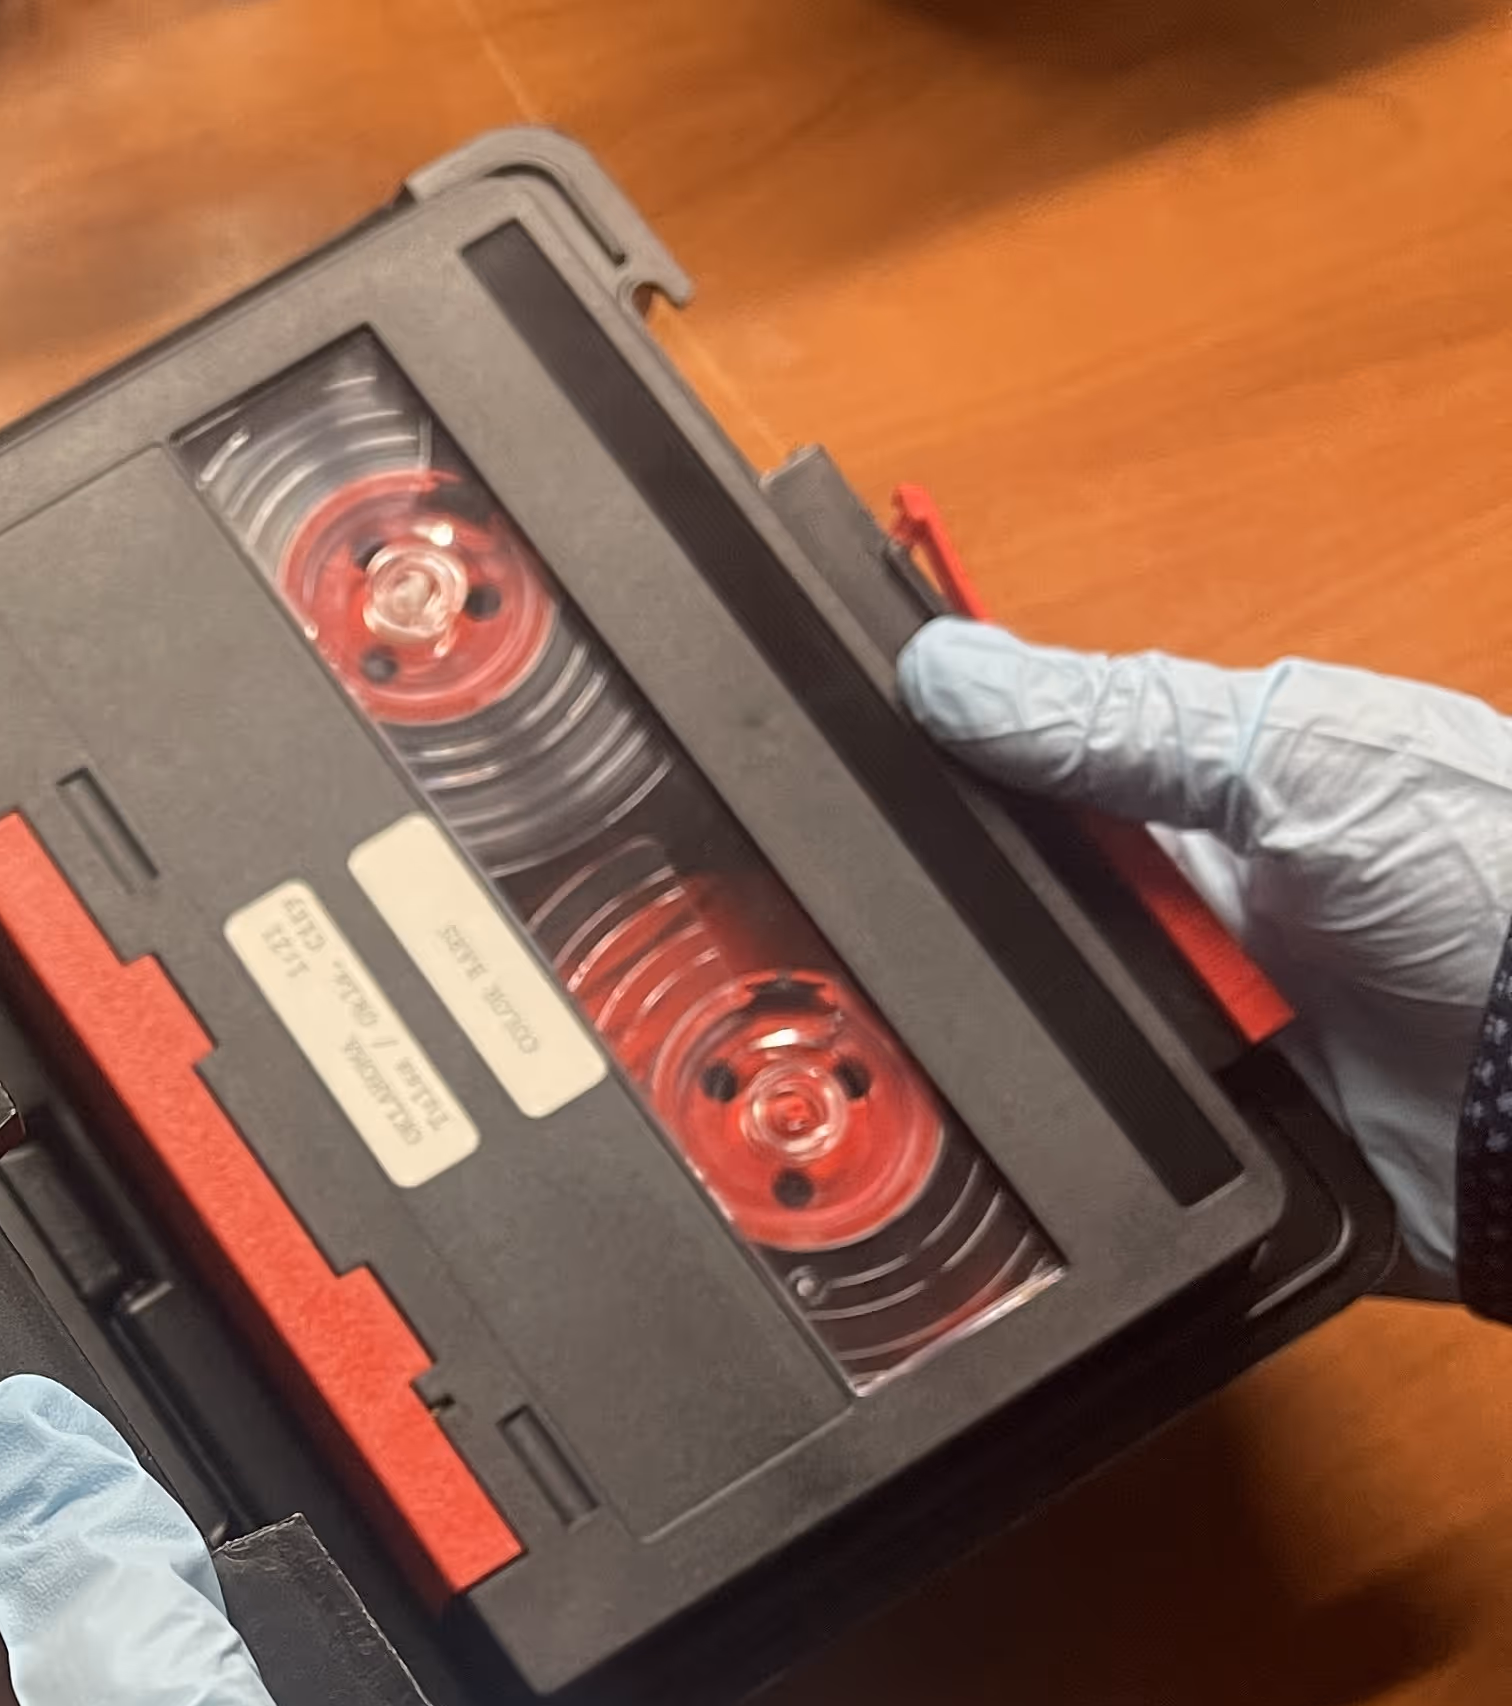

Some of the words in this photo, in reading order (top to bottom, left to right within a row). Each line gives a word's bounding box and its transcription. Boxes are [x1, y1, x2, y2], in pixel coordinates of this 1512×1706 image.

[439, 924, 488, 981] BARS
[483, 984, 541, 1056] COLOR
[344, 1033, 423, 1146] OKLAHOMA
[394, 1057, 450, 1132] Tulsa
